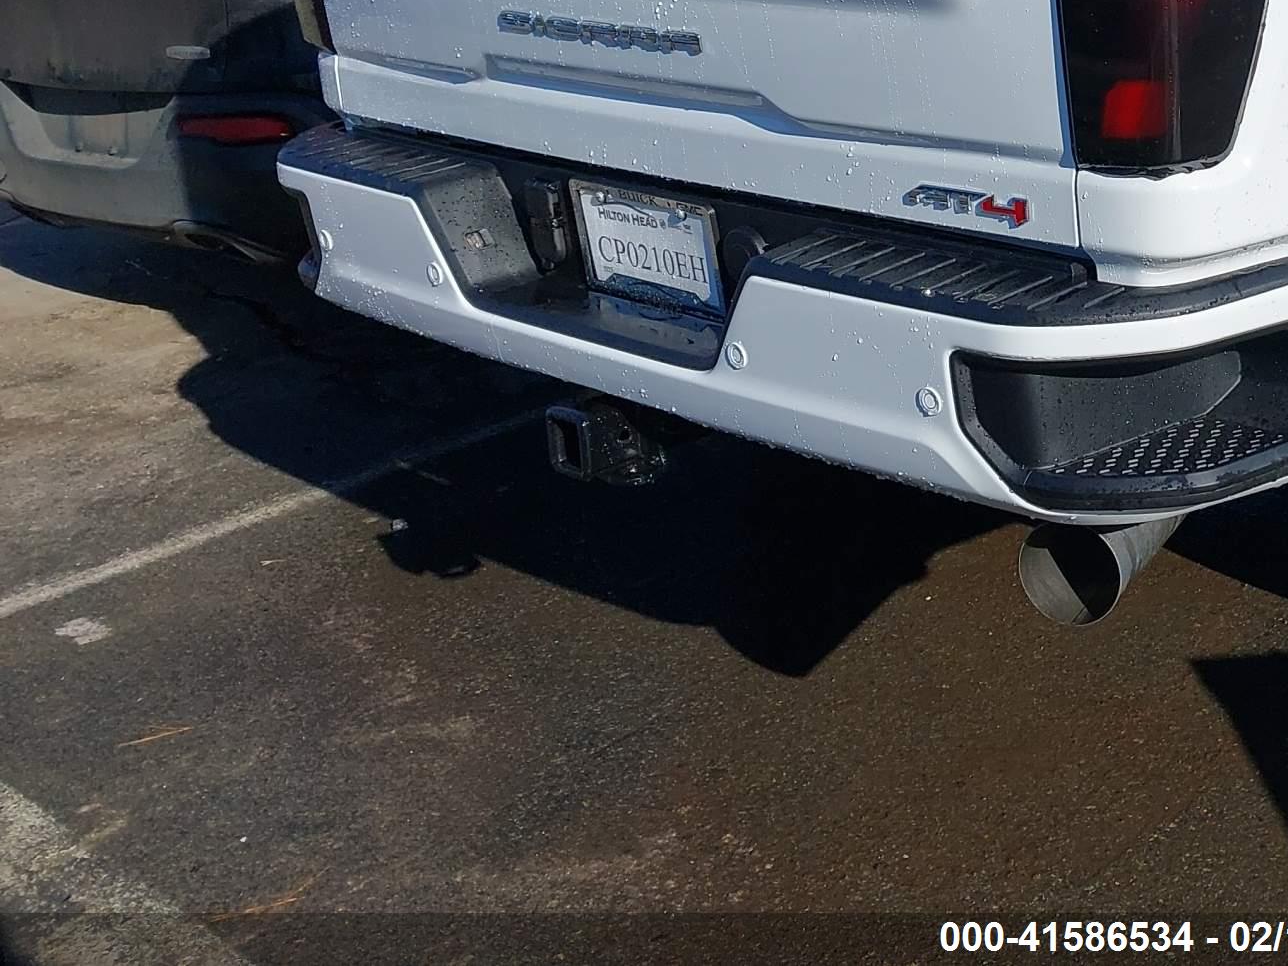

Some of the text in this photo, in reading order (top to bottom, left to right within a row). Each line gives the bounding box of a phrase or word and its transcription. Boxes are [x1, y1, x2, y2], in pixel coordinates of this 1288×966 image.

[617, 189, 658, 208] BUICK
[901, 184, 1030, 230] AT4
[598, 206, 658, 230] HILTON HEAD
[598, 235, 709, 284] CP0210EH
